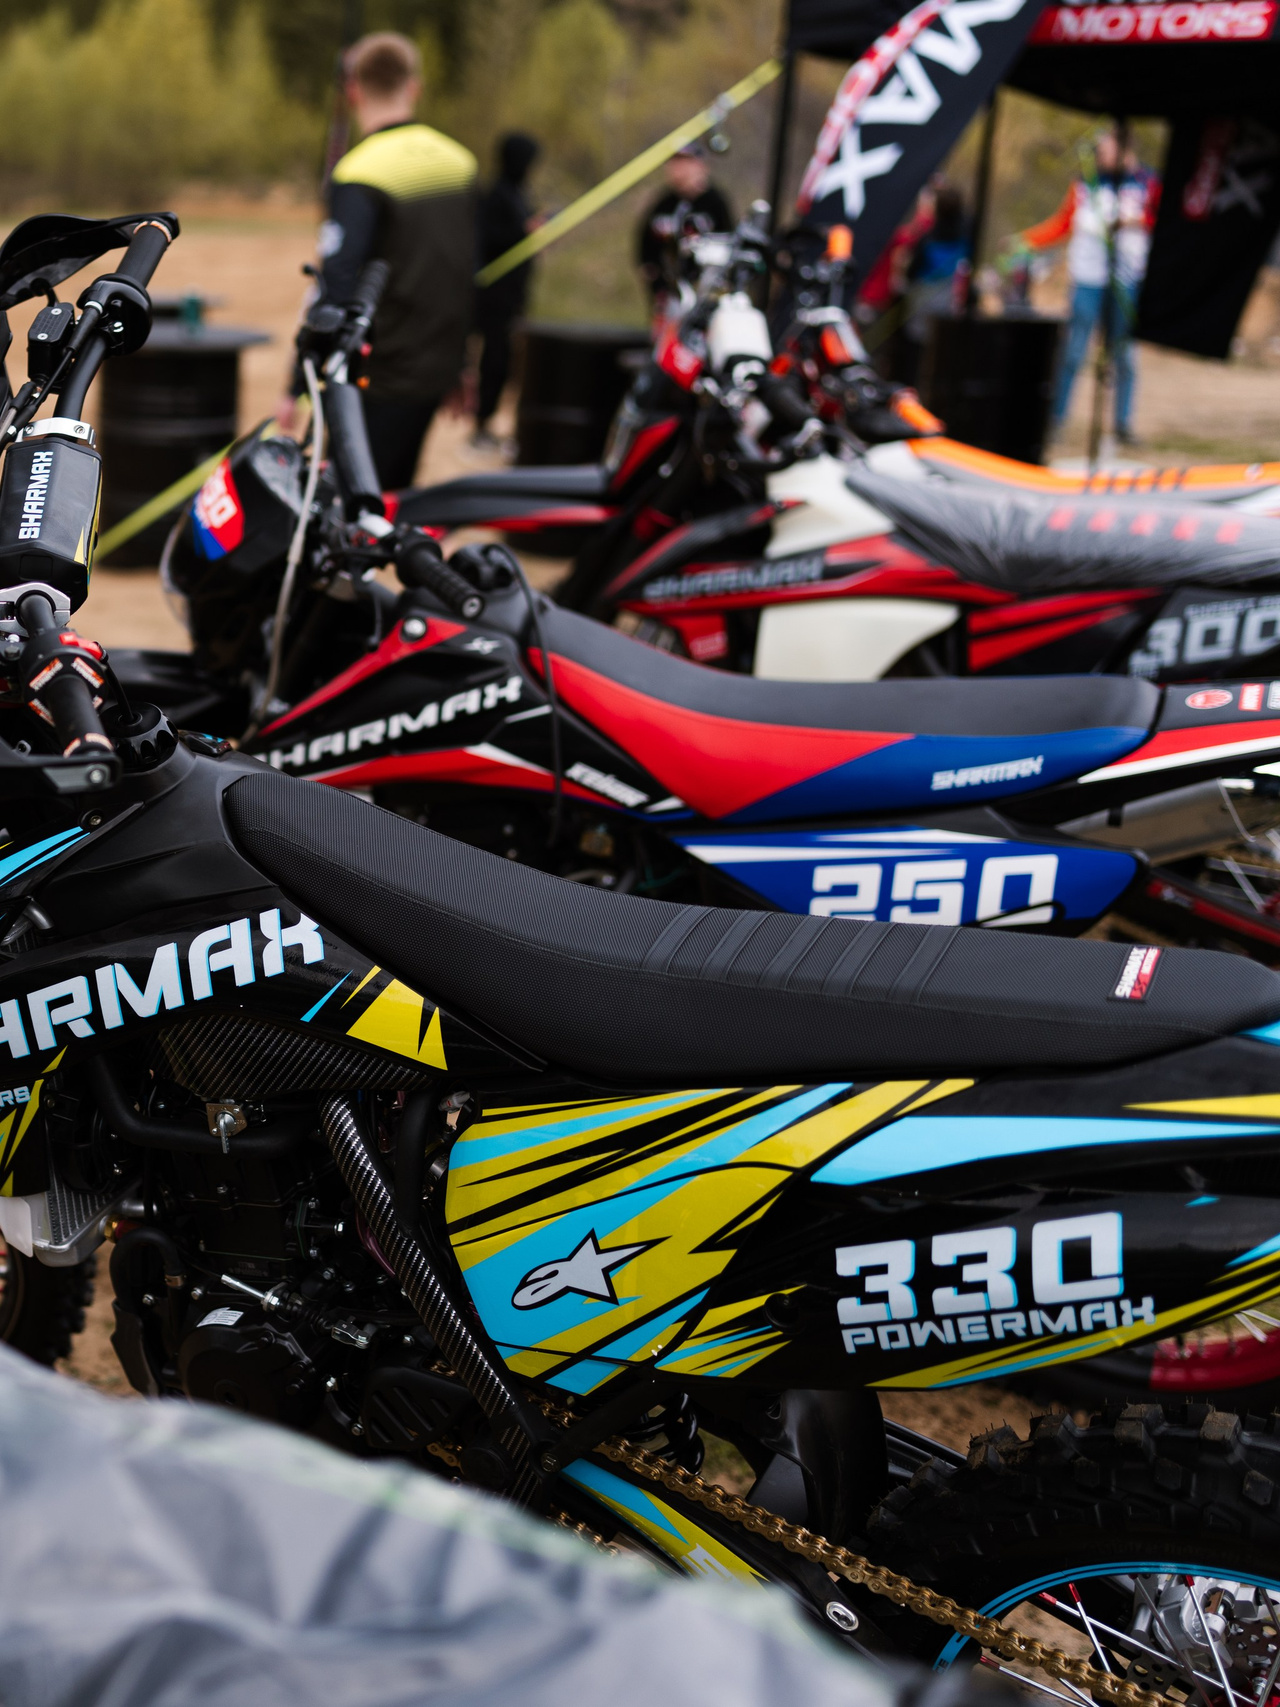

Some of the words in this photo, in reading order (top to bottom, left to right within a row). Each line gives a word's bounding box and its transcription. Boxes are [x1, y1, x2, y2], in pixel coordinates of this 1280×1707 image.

[1051, 1, 1273, 42] MOTORS
[18, 451, 54, 540] SHARMAX
[1128, 602, 1280, 673] 300
[931, 754, 1044, 791] SHARMAX
[810, 853, 1059, 928] 250
[1114, 945, 1147, 999] SHARMAX
[835, 1211, 1125, 1325] 330
[841, 1296, 1157, 1354] POWERMAX
